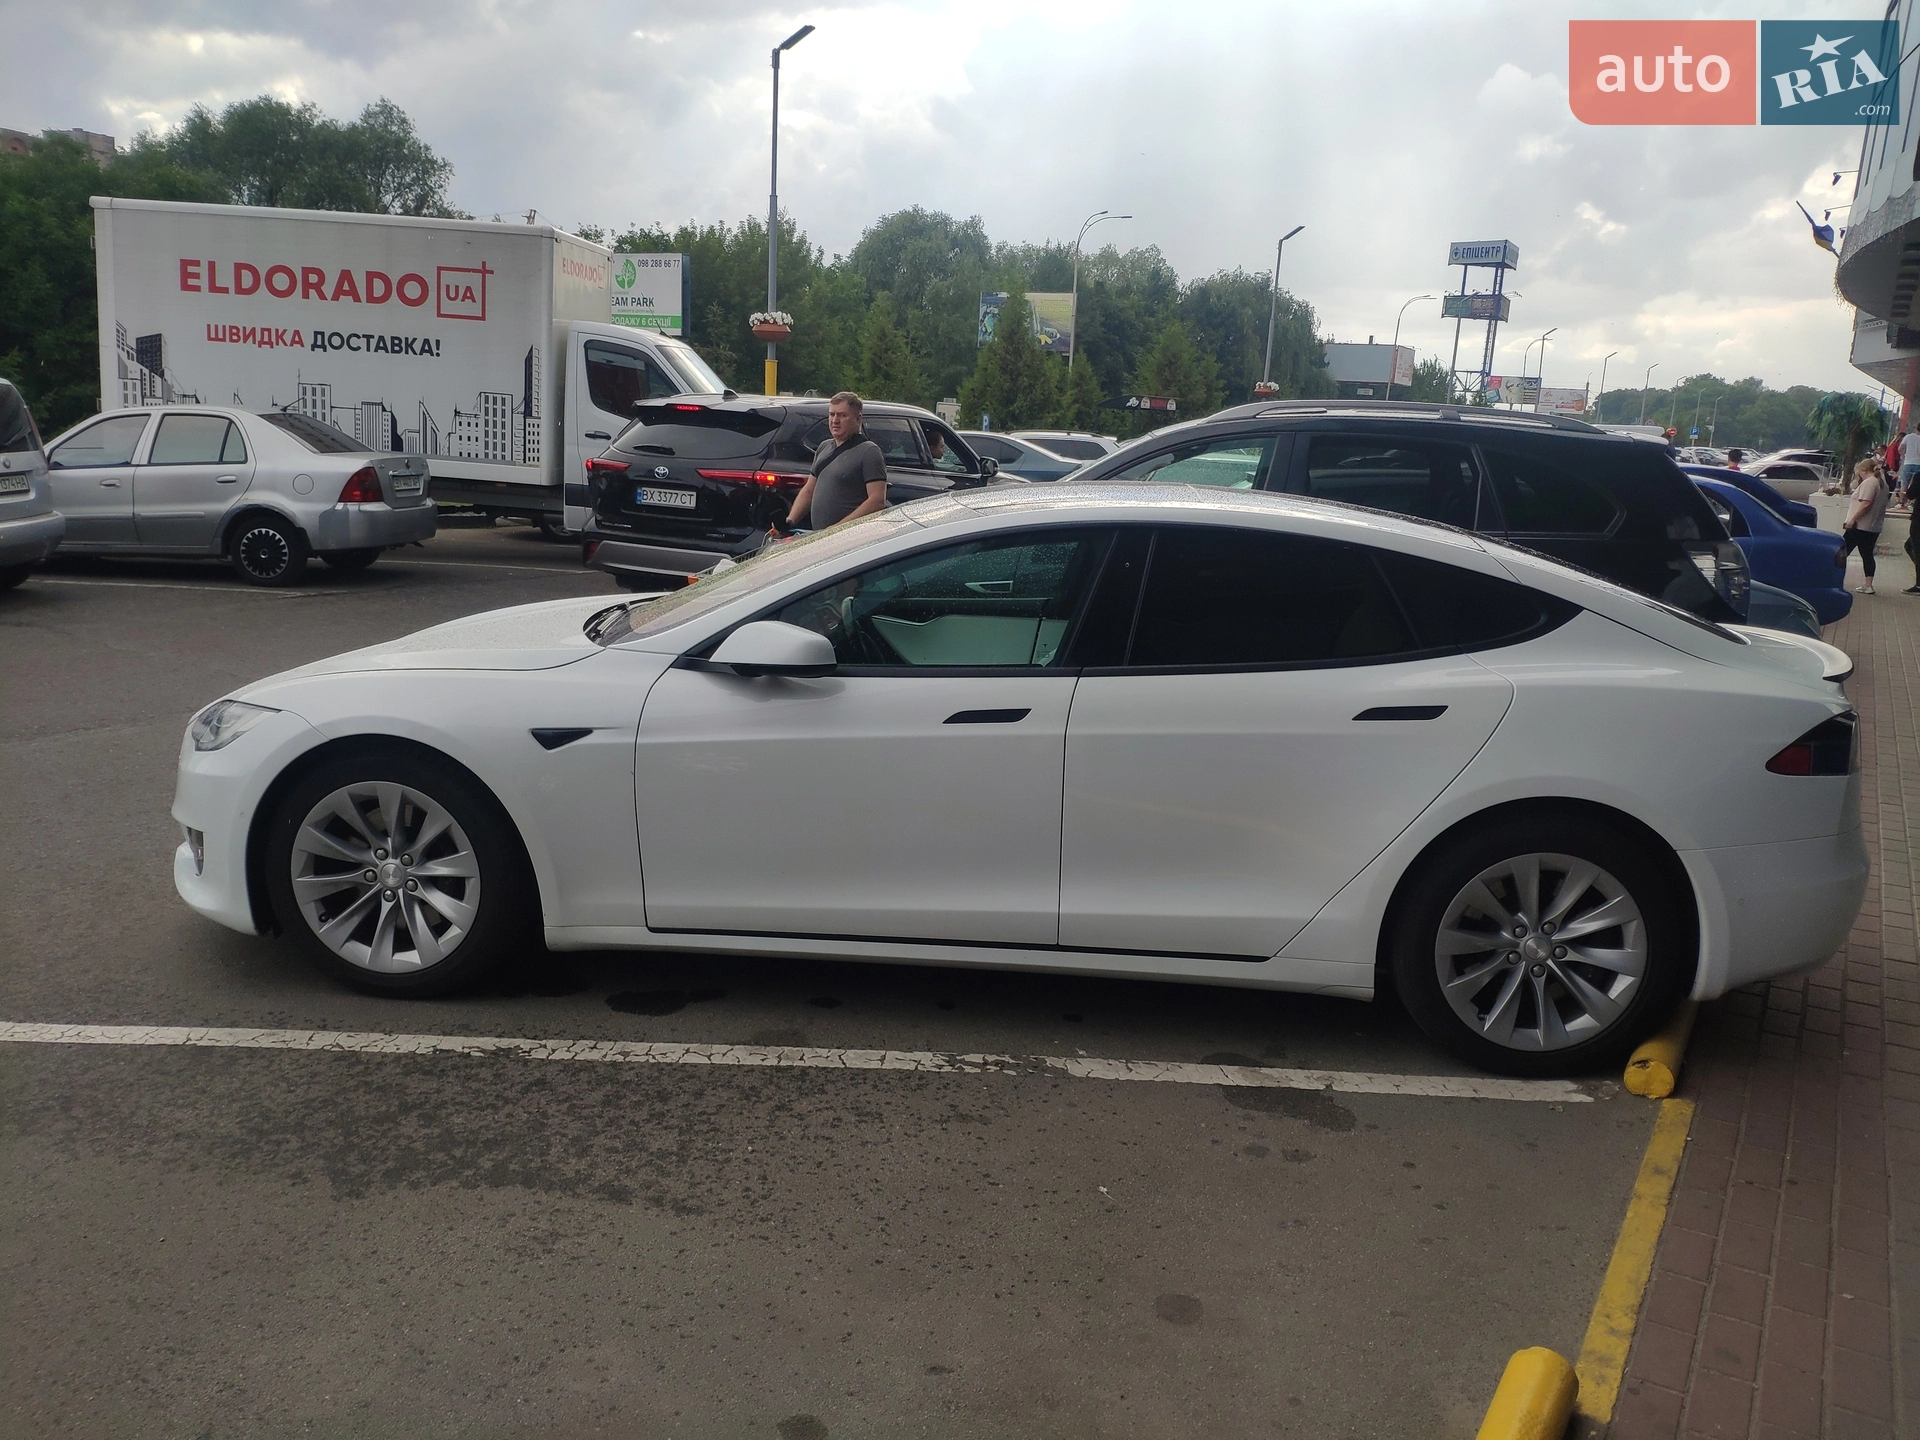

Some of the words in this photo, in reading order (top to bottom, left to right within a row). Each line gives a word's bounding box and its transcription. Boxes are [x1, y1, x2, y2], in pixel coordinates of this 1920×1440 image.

[1461, 245, 1502, 259] ЕПІЦЕНТР
[563, 257, 597, 283] ELDORADO
[637, 259, 649, 268] 098
[650, 259, 662, 268] 288
[663, 259, 672, 268] 66
[673, 260, 681, 268] 77
[179, 258, 430, 308] ELDORADO
[445, 284, 477, 303] UA
[631, 297, 655, 307] PARK
[641, 317, 646, 326] 6
[206, 323, 305, 349] ШВИДКА
[311, 331, 441, 357] ДОСТАВКА!
[642, 489, 655, 501] BX
[656, 491, 678, 504] 3377
[680, 494, 694, 504] CT
